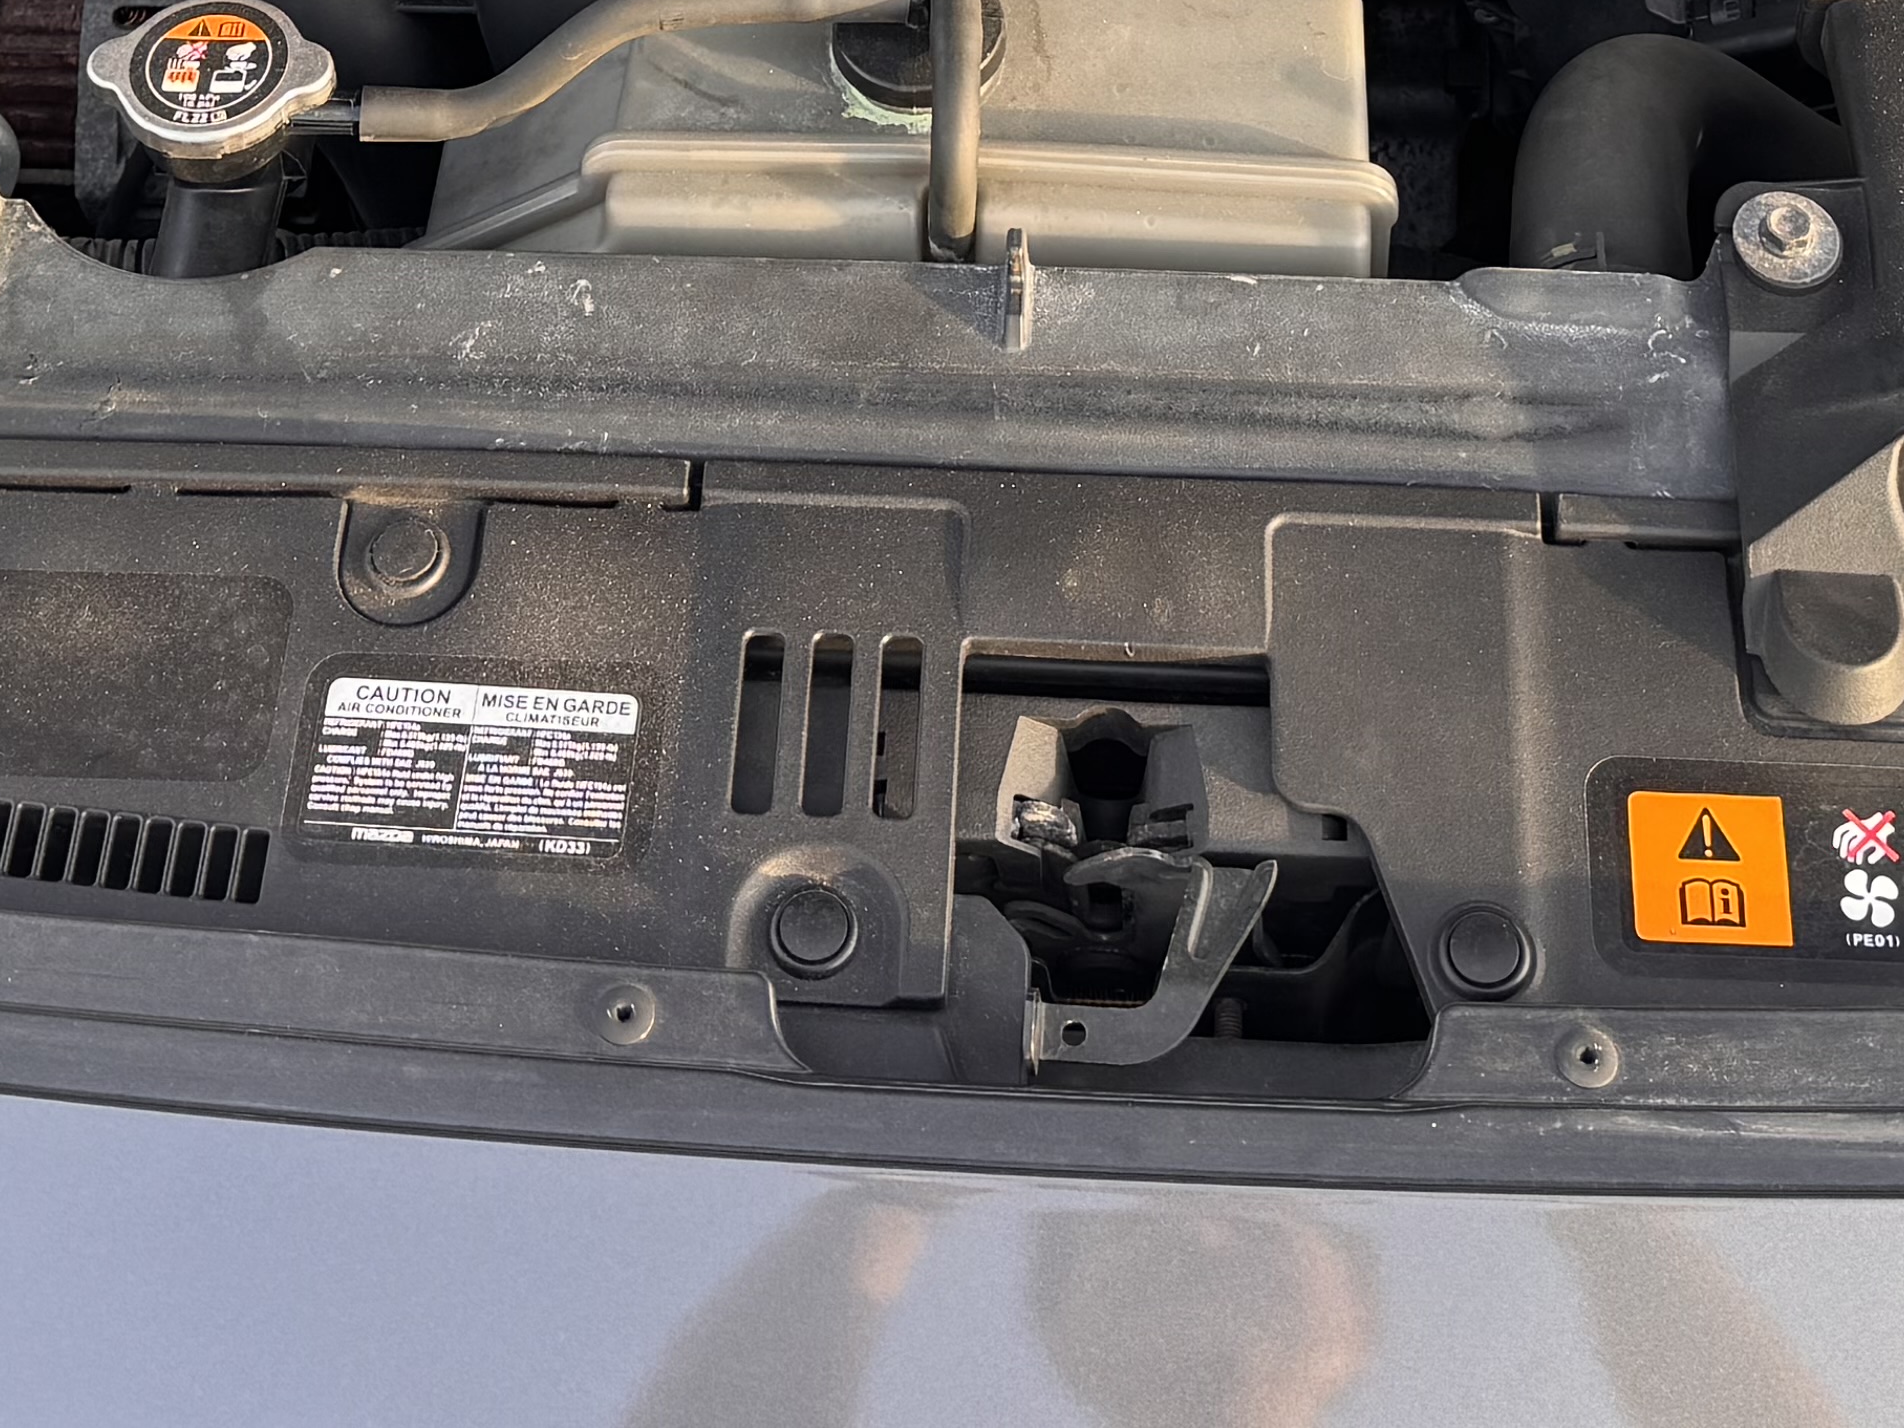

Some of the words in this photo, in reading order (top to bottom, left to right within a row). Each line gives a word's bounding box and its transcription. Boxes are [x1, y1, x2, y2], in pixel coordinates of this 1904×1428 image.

[356, 684, 452, 705] CAUTION
[337, 702, 361, 714] AIR
[365, 703, 463, 720] CONDITIONER
[482, 693, 529, 710] MISE
[533, 696, 560, 712] EN
[563, 698, 632, 717] GARDE
[505, 712, 600, 728] CLIMATISEUR
[539, 839, 591, 855] (KD33)
[1845, 932, 1900, 948] (PE01)
